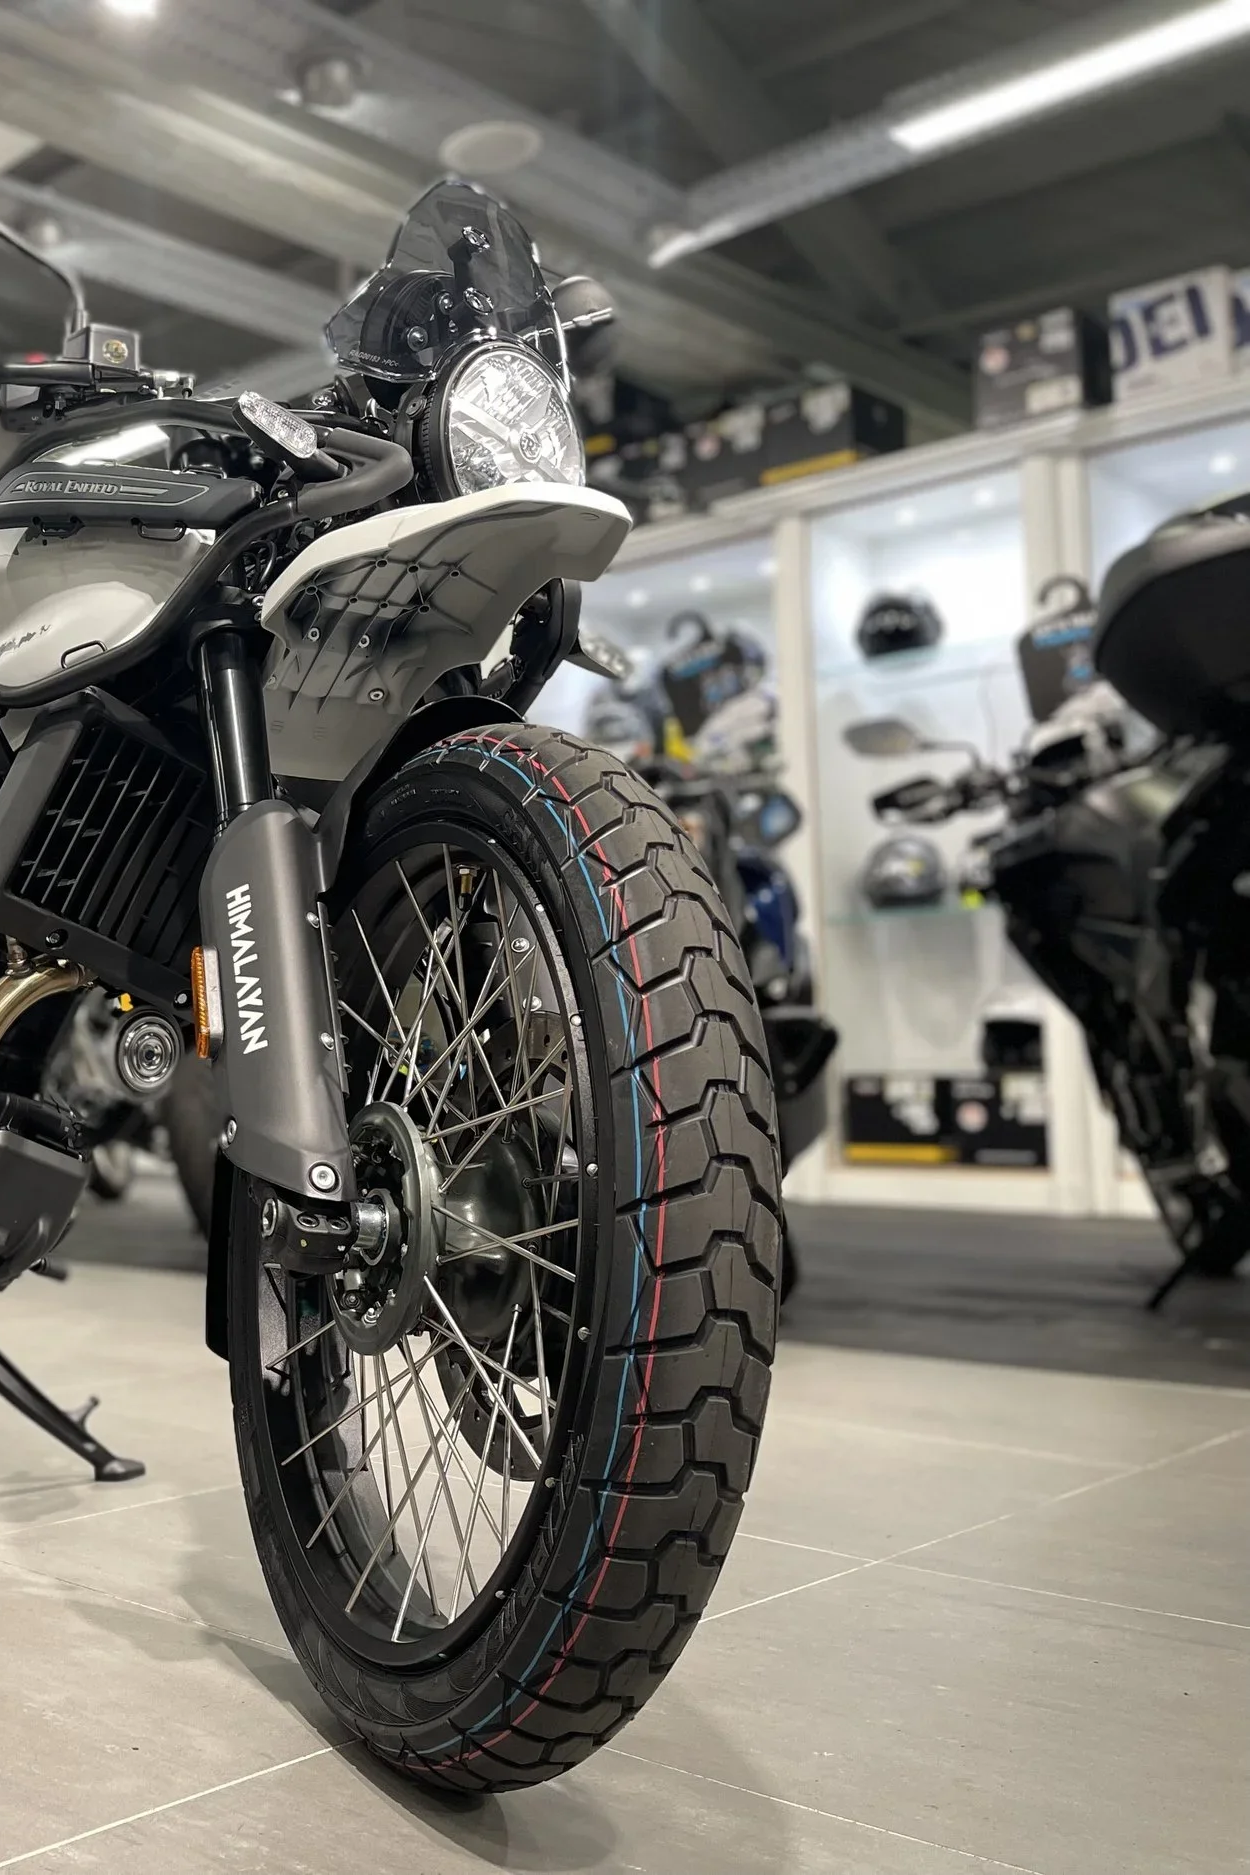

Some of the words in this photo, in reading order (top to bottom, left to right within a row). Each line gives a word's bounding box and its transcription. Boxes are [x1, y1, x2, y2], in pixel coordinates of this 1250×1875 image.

[24, 480, 63, 494] ROYAL
[63, 479, 119, 496] ENFIELD
[225, 883, 269, 1055] HIMALAYAN
